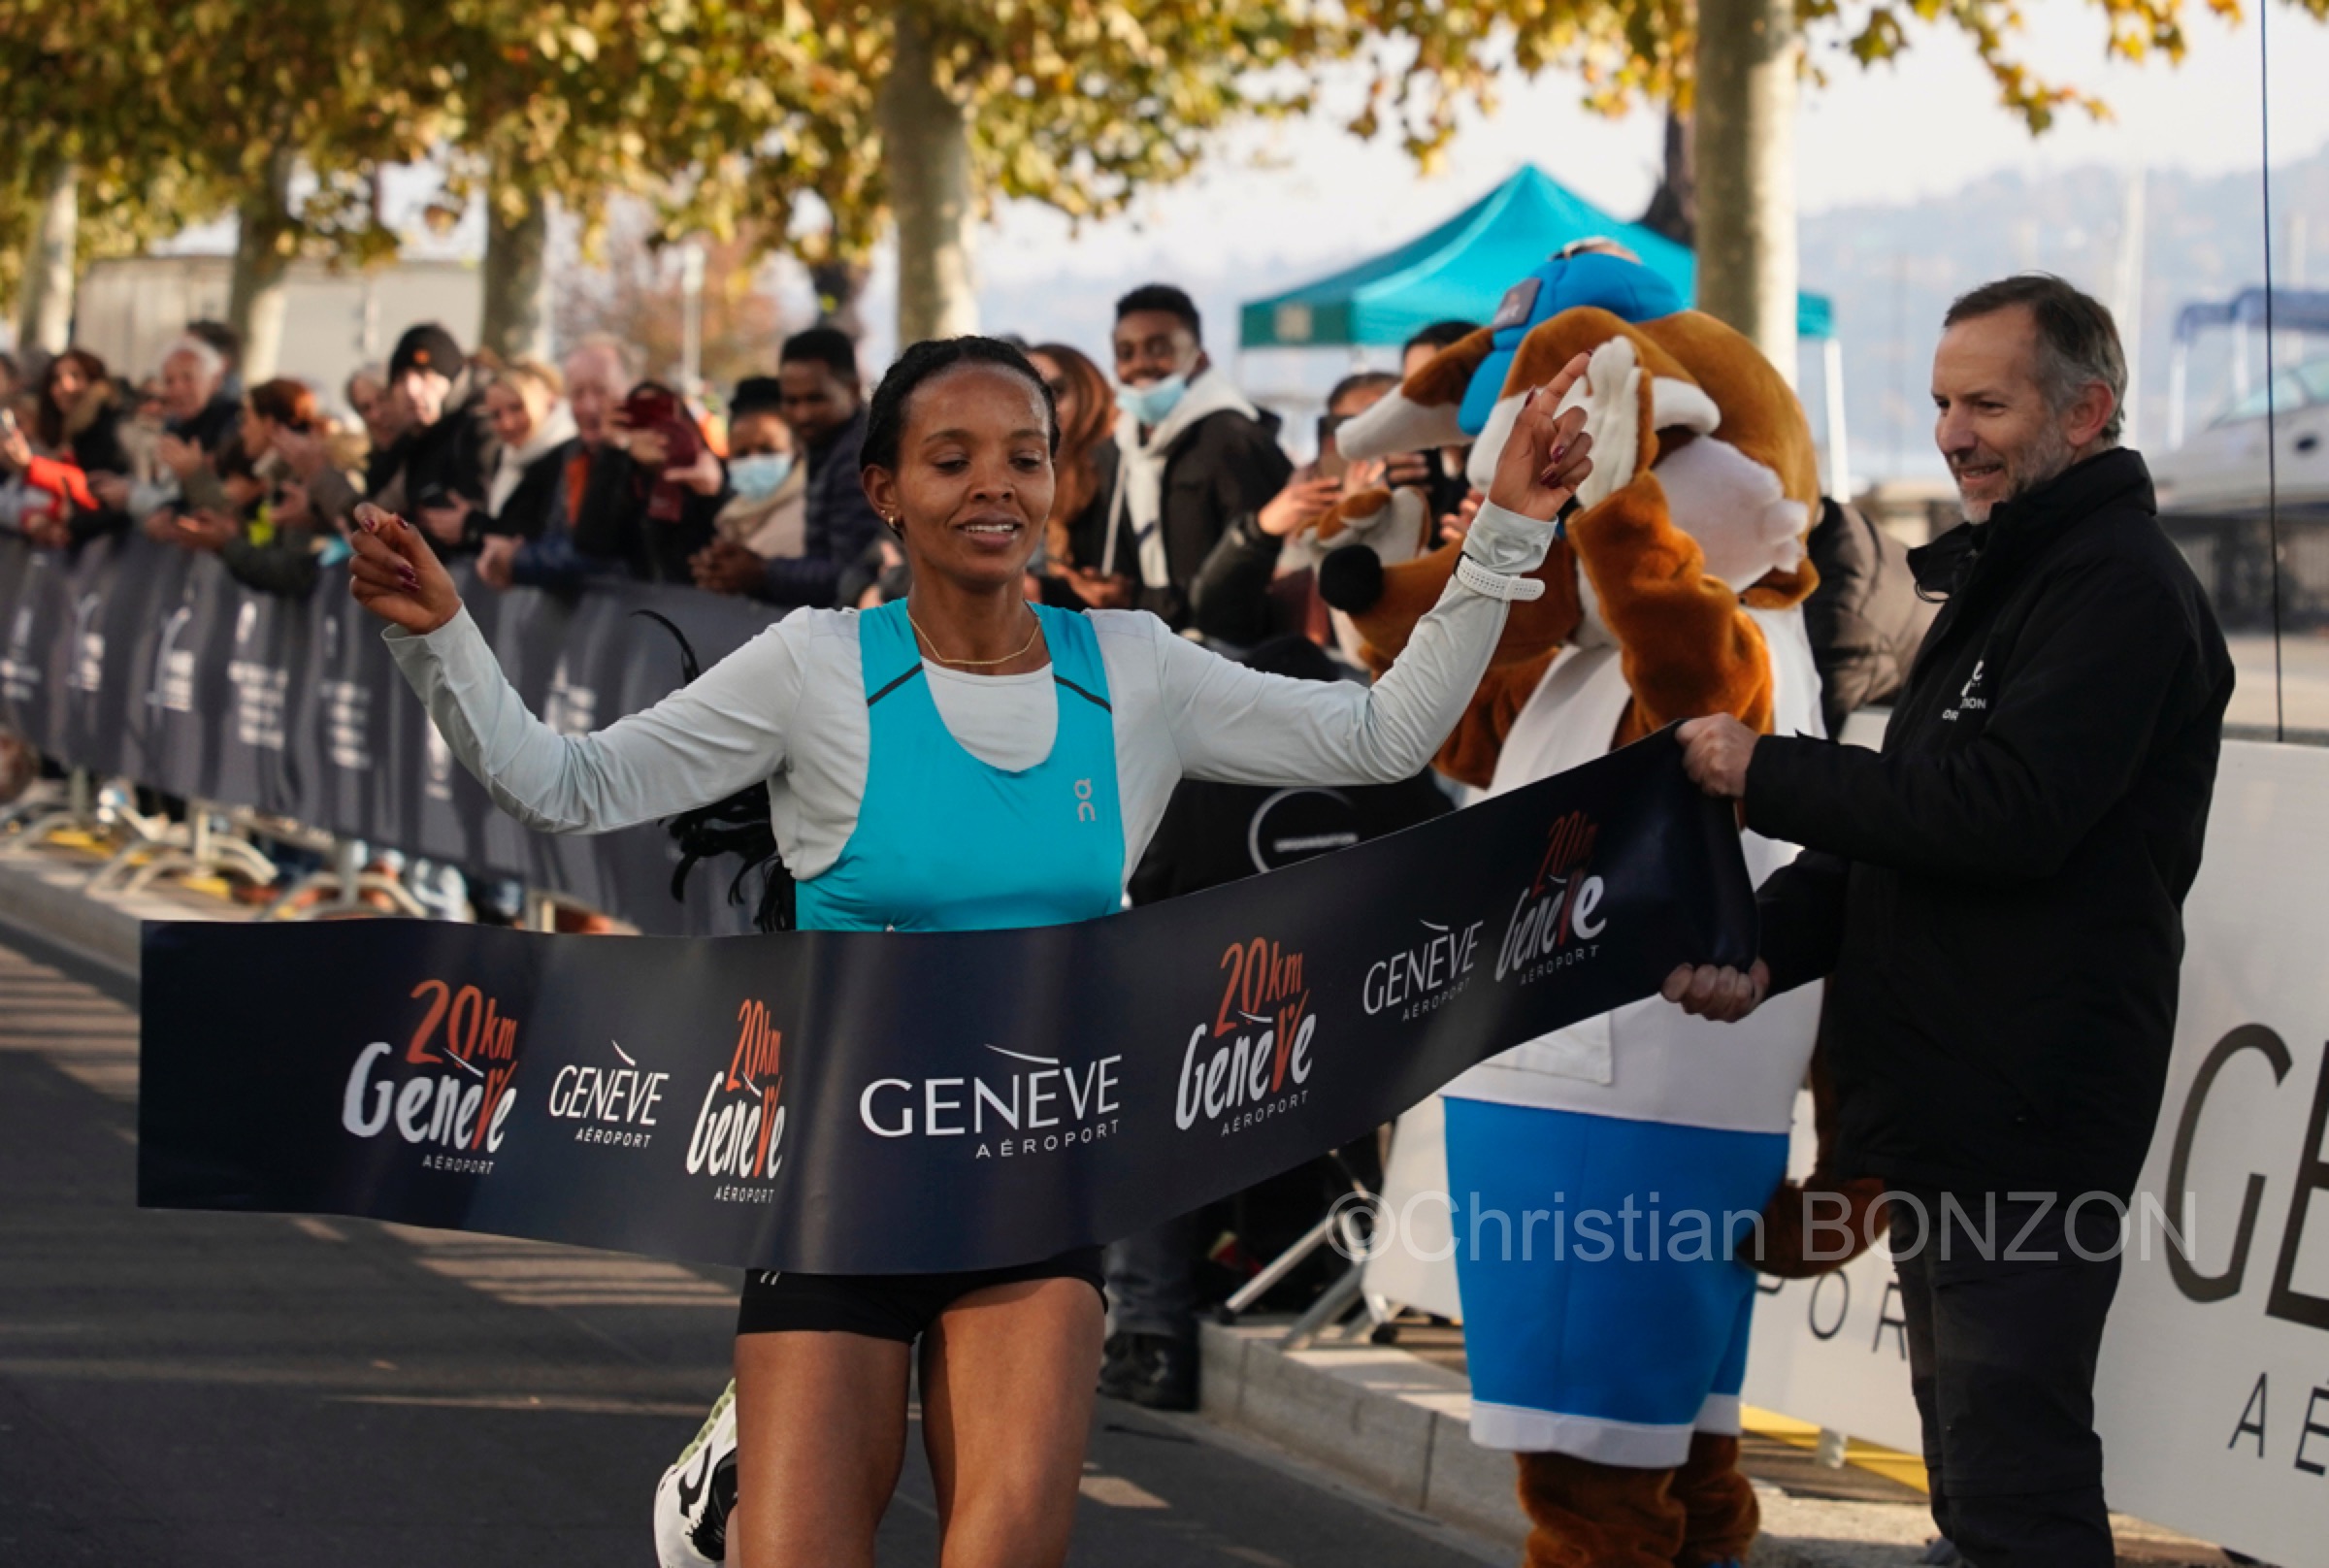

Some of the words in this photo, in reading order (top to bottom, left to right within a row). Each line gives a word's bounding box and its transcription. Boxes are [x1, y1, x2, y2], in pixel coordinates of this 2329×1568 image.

[1214, 937, 1304, 1038] 20km
[1362, 919, 1484, 1015] GENÈVE
[406, 979, 518, 1068] 20km
[725, 998, 782, 1092] 20km
[1174, 989, 1318, 1131] Genève
[343, 1042, 519, 1154] Genève
[548, 1039, 671, 1127] GENÈVE
[685, 1070, 785, 1180] Genève
[859, 1043, 1123, 1138] GENÈVE
[1221, 1090, 1309, 1137] AÉROPORT
[574, 1126, 652, 1149] AÉROPORT
[974, 1118, 1121, 1160] AÉROPORT
[713, 1183, 776, 1204] AÉROPORT
